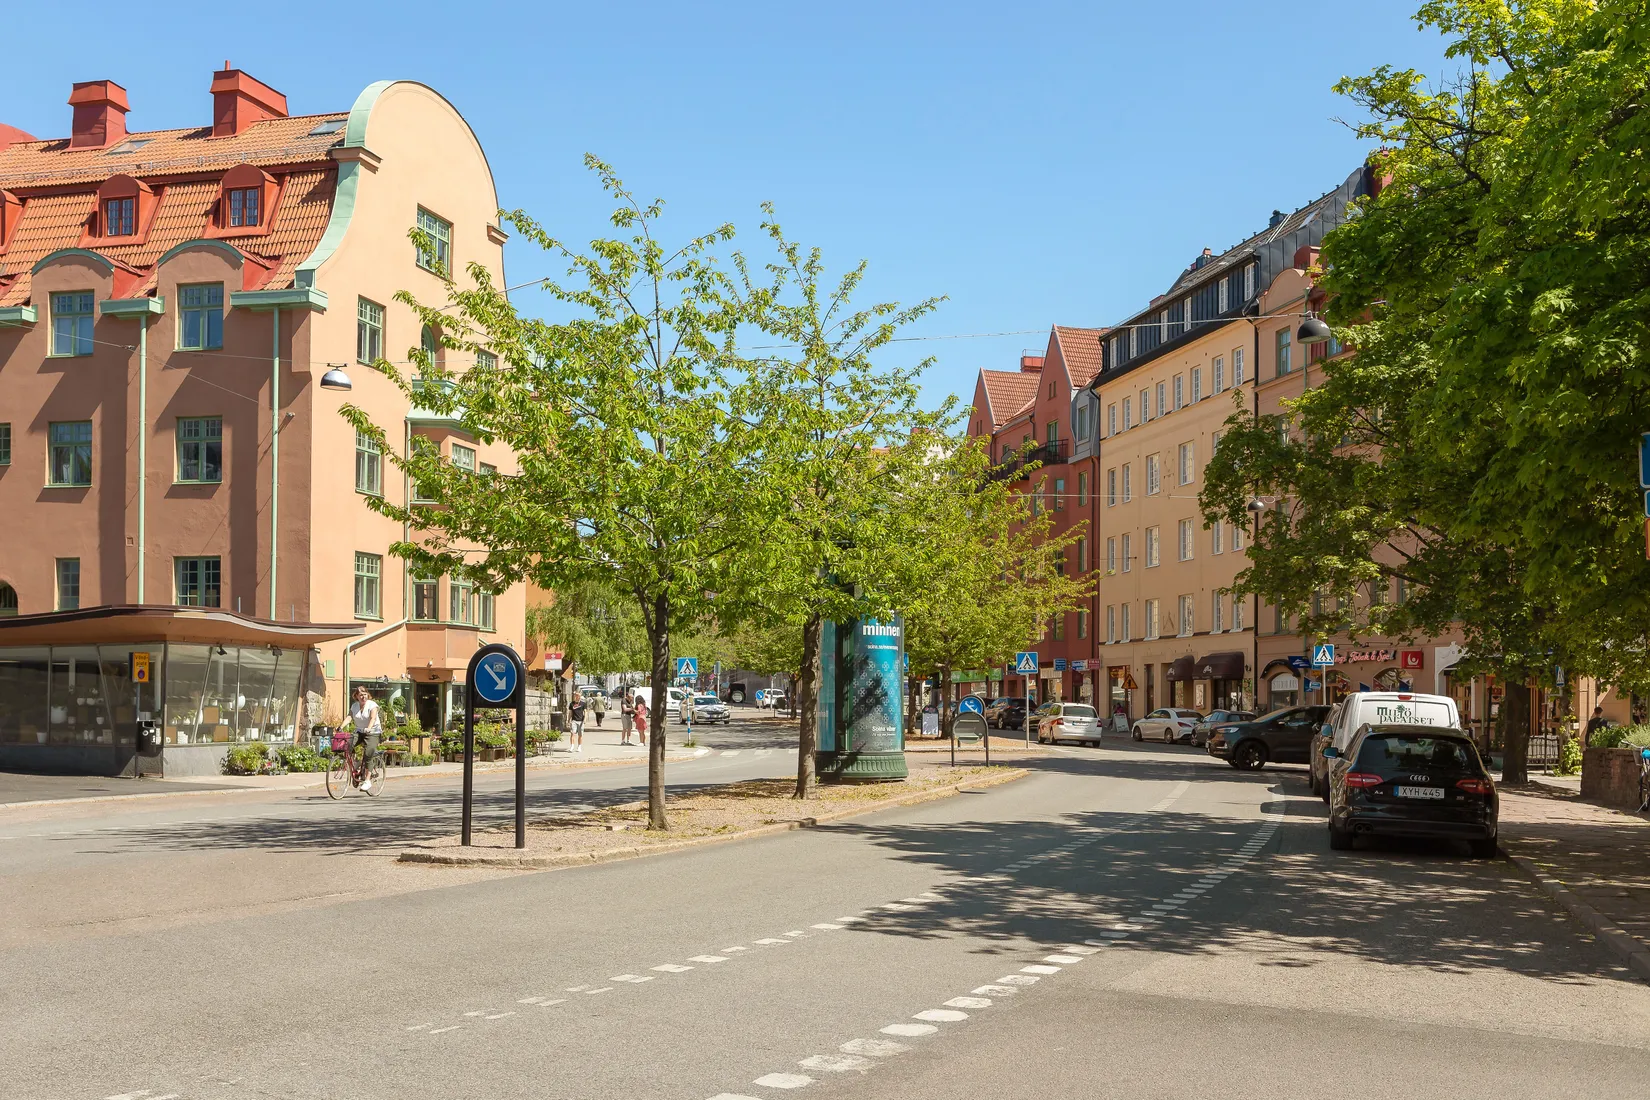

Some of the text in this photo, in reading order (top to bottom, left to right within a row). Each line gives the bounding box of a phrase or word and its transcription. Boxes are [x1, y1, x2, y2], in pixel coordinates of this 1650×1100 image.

[862, 622, 900, 637] minnen
[1379, 714, 1435, 725] PALATSET
[1402, 787, 1441, 797] XYH 445
